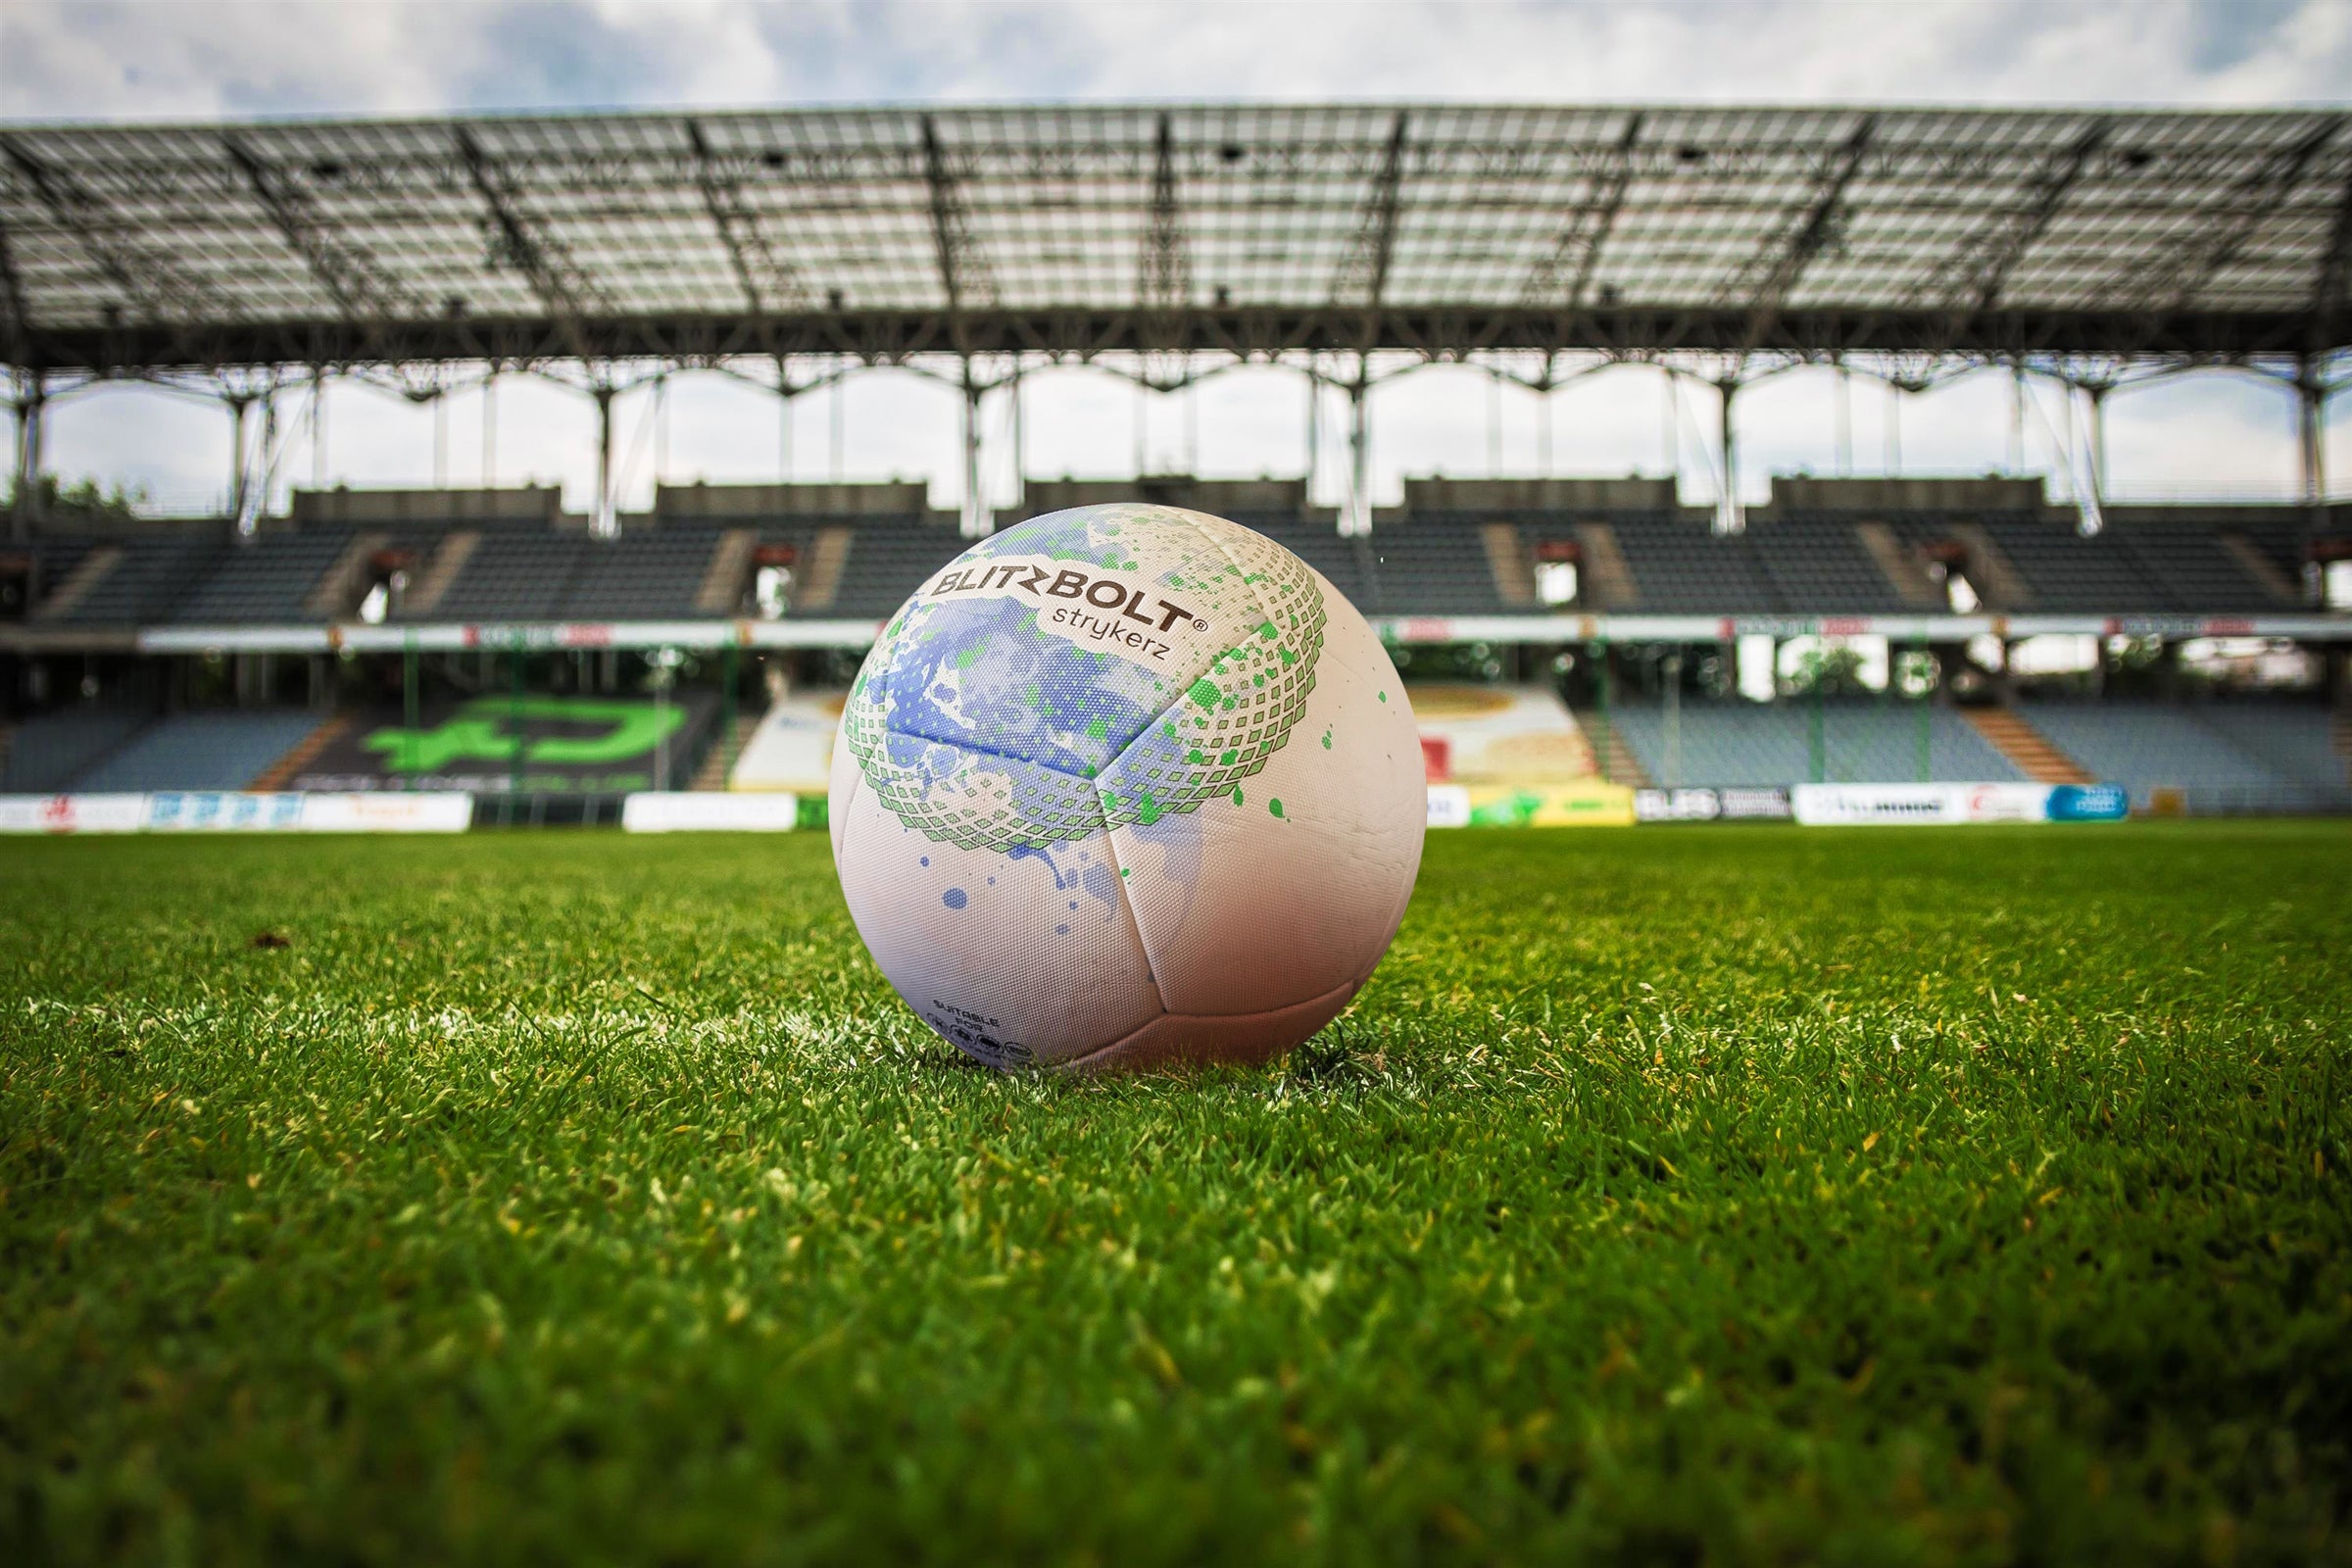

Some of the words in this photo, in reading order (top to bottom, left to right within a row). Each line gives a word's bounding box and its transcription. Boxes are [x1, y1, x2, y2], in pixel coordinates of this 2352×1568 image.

[1052, 607, 1172, 662] strykerz
[933, 999, 1000, 1027] SUITABLE
[955, 1016, 983, 1032] FOR
